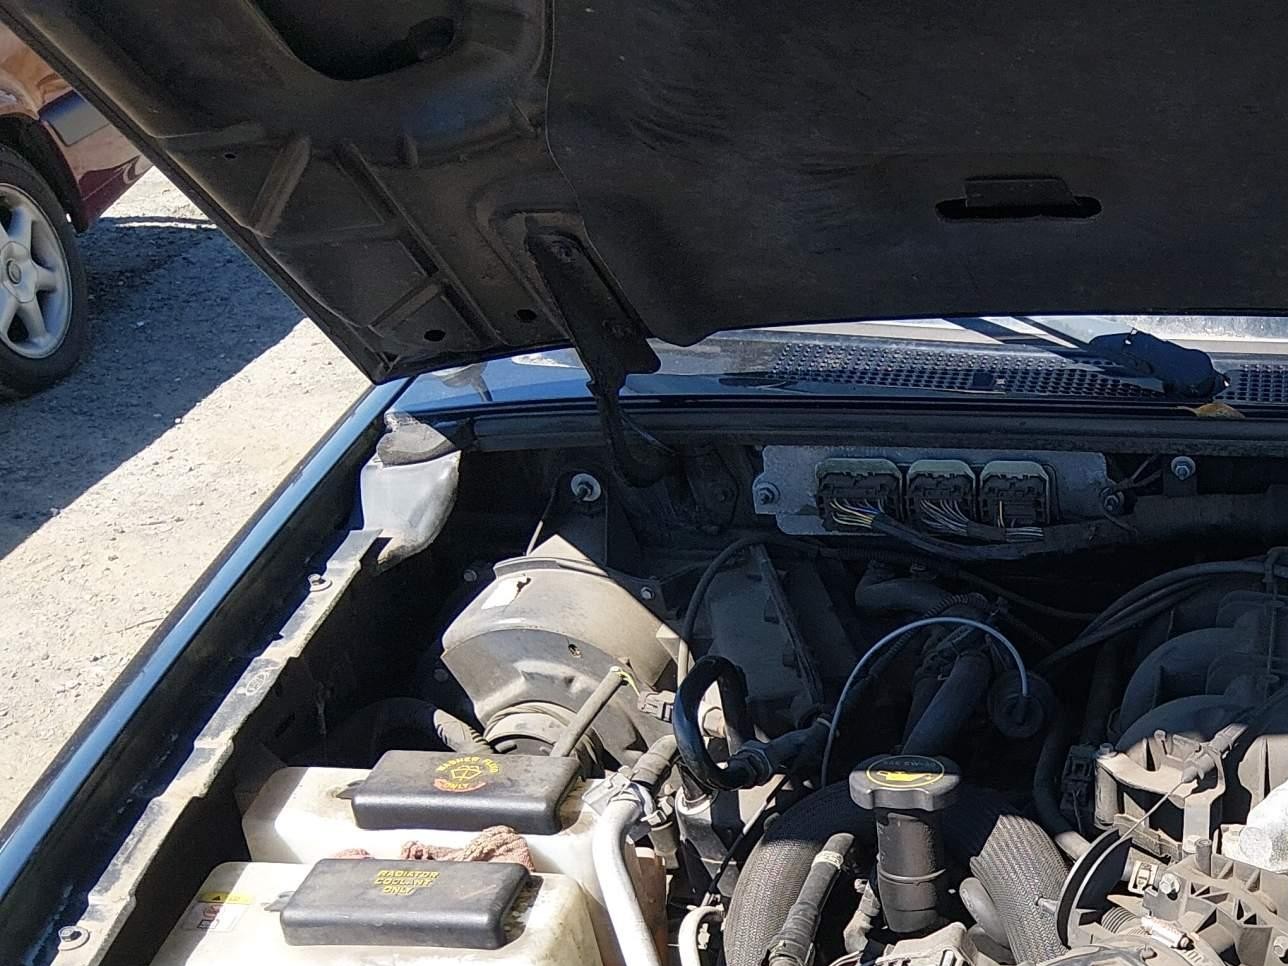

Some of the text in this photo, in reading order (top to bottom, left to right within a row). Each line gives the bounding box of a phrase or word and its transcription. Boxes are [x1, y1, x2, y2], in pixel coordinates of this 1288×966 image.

[377, 870, 440, 879] RADIATOR
[374, 877, 433, 886] COOLANT
[383, 885, 415, 895] ONLY
